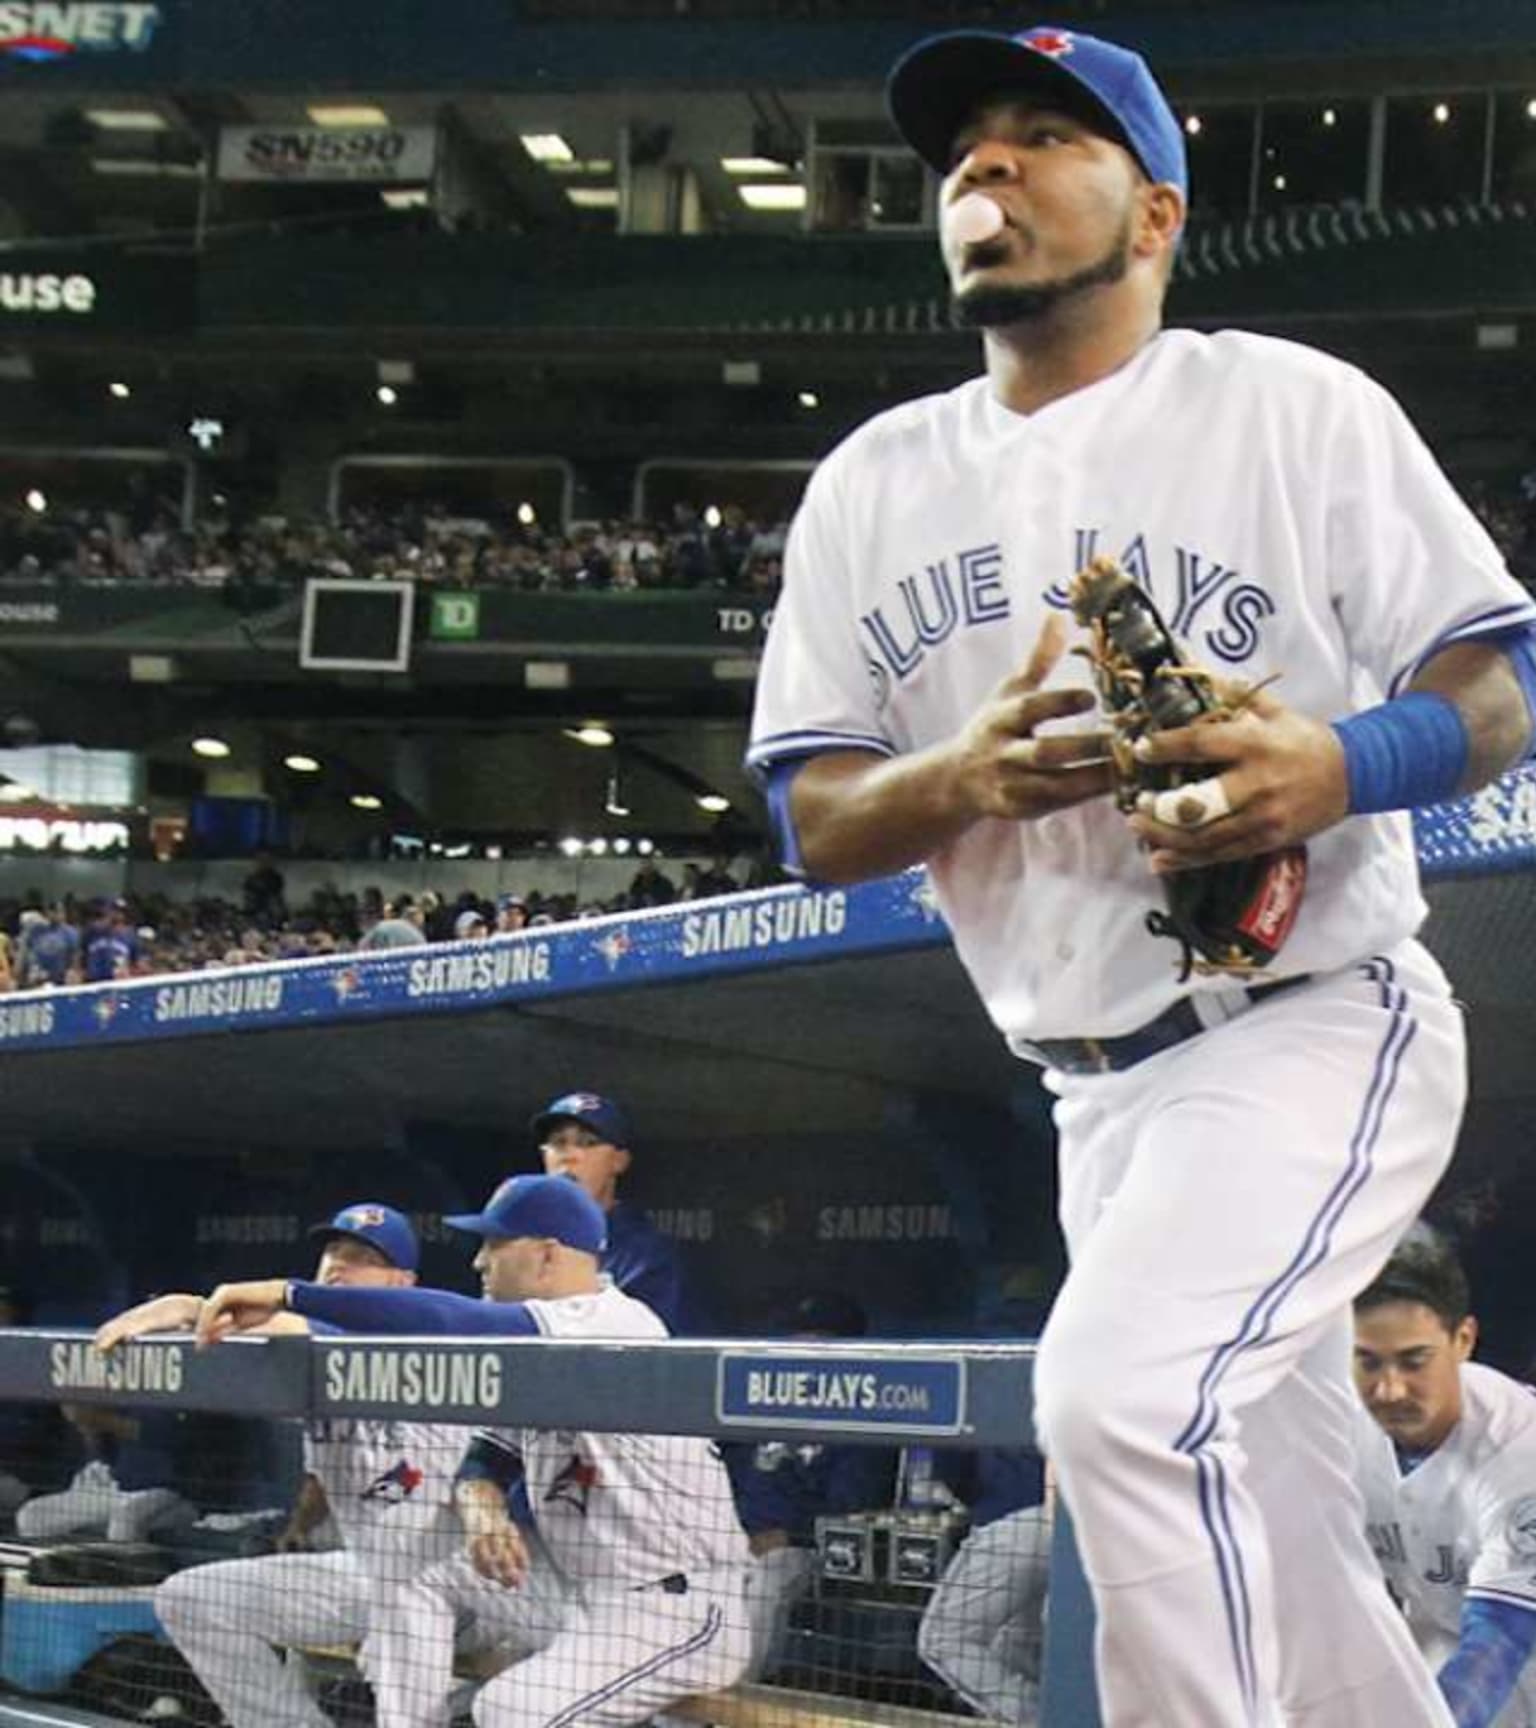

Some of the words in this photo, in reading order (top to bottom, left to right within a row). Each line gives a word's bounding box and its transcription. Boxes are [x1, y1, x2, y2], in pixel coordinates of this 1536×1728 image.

[0, 273, 96, 312] use
[718, 609, 755, 631] TD
[683, 888, 847, 958] SAMSUNG
[407, 941, 550, 997] SAMSUNG
[154, 975, 284, 1022] SAMSUNG
[51, 1342, 182, 1392] SAMSUNG
[326, 1350, 500, 1407] SAMSUNG
